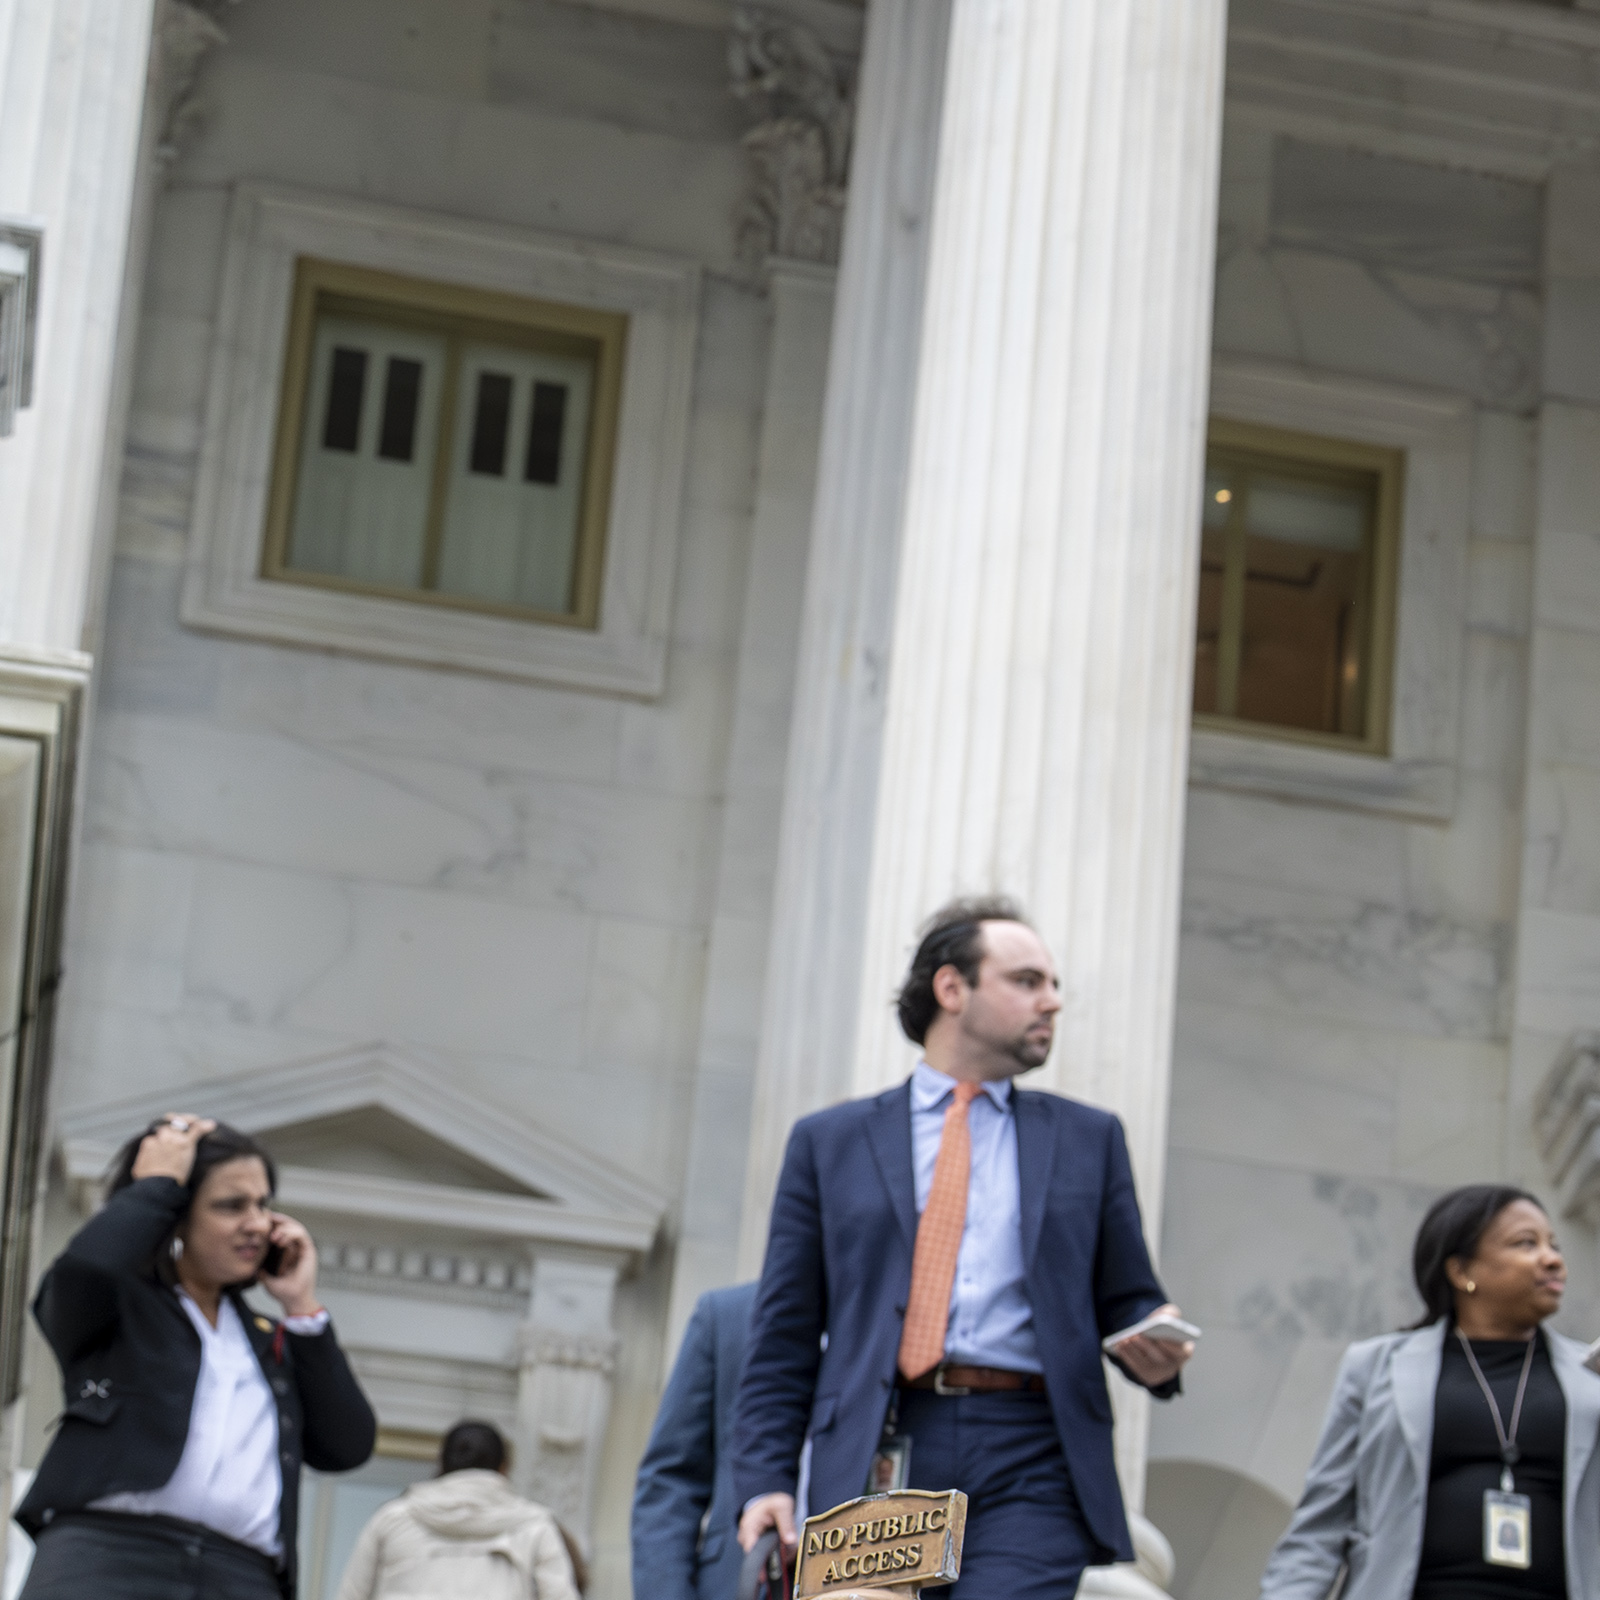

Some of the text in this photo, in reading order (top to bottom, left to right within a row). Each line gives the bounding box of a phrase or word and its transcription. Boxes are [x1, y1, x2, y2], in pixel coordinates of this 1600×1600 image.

[807, 1506, 948, 1556] NO PUBLIC
[822, 1543, 923, 1585] ACCESS
